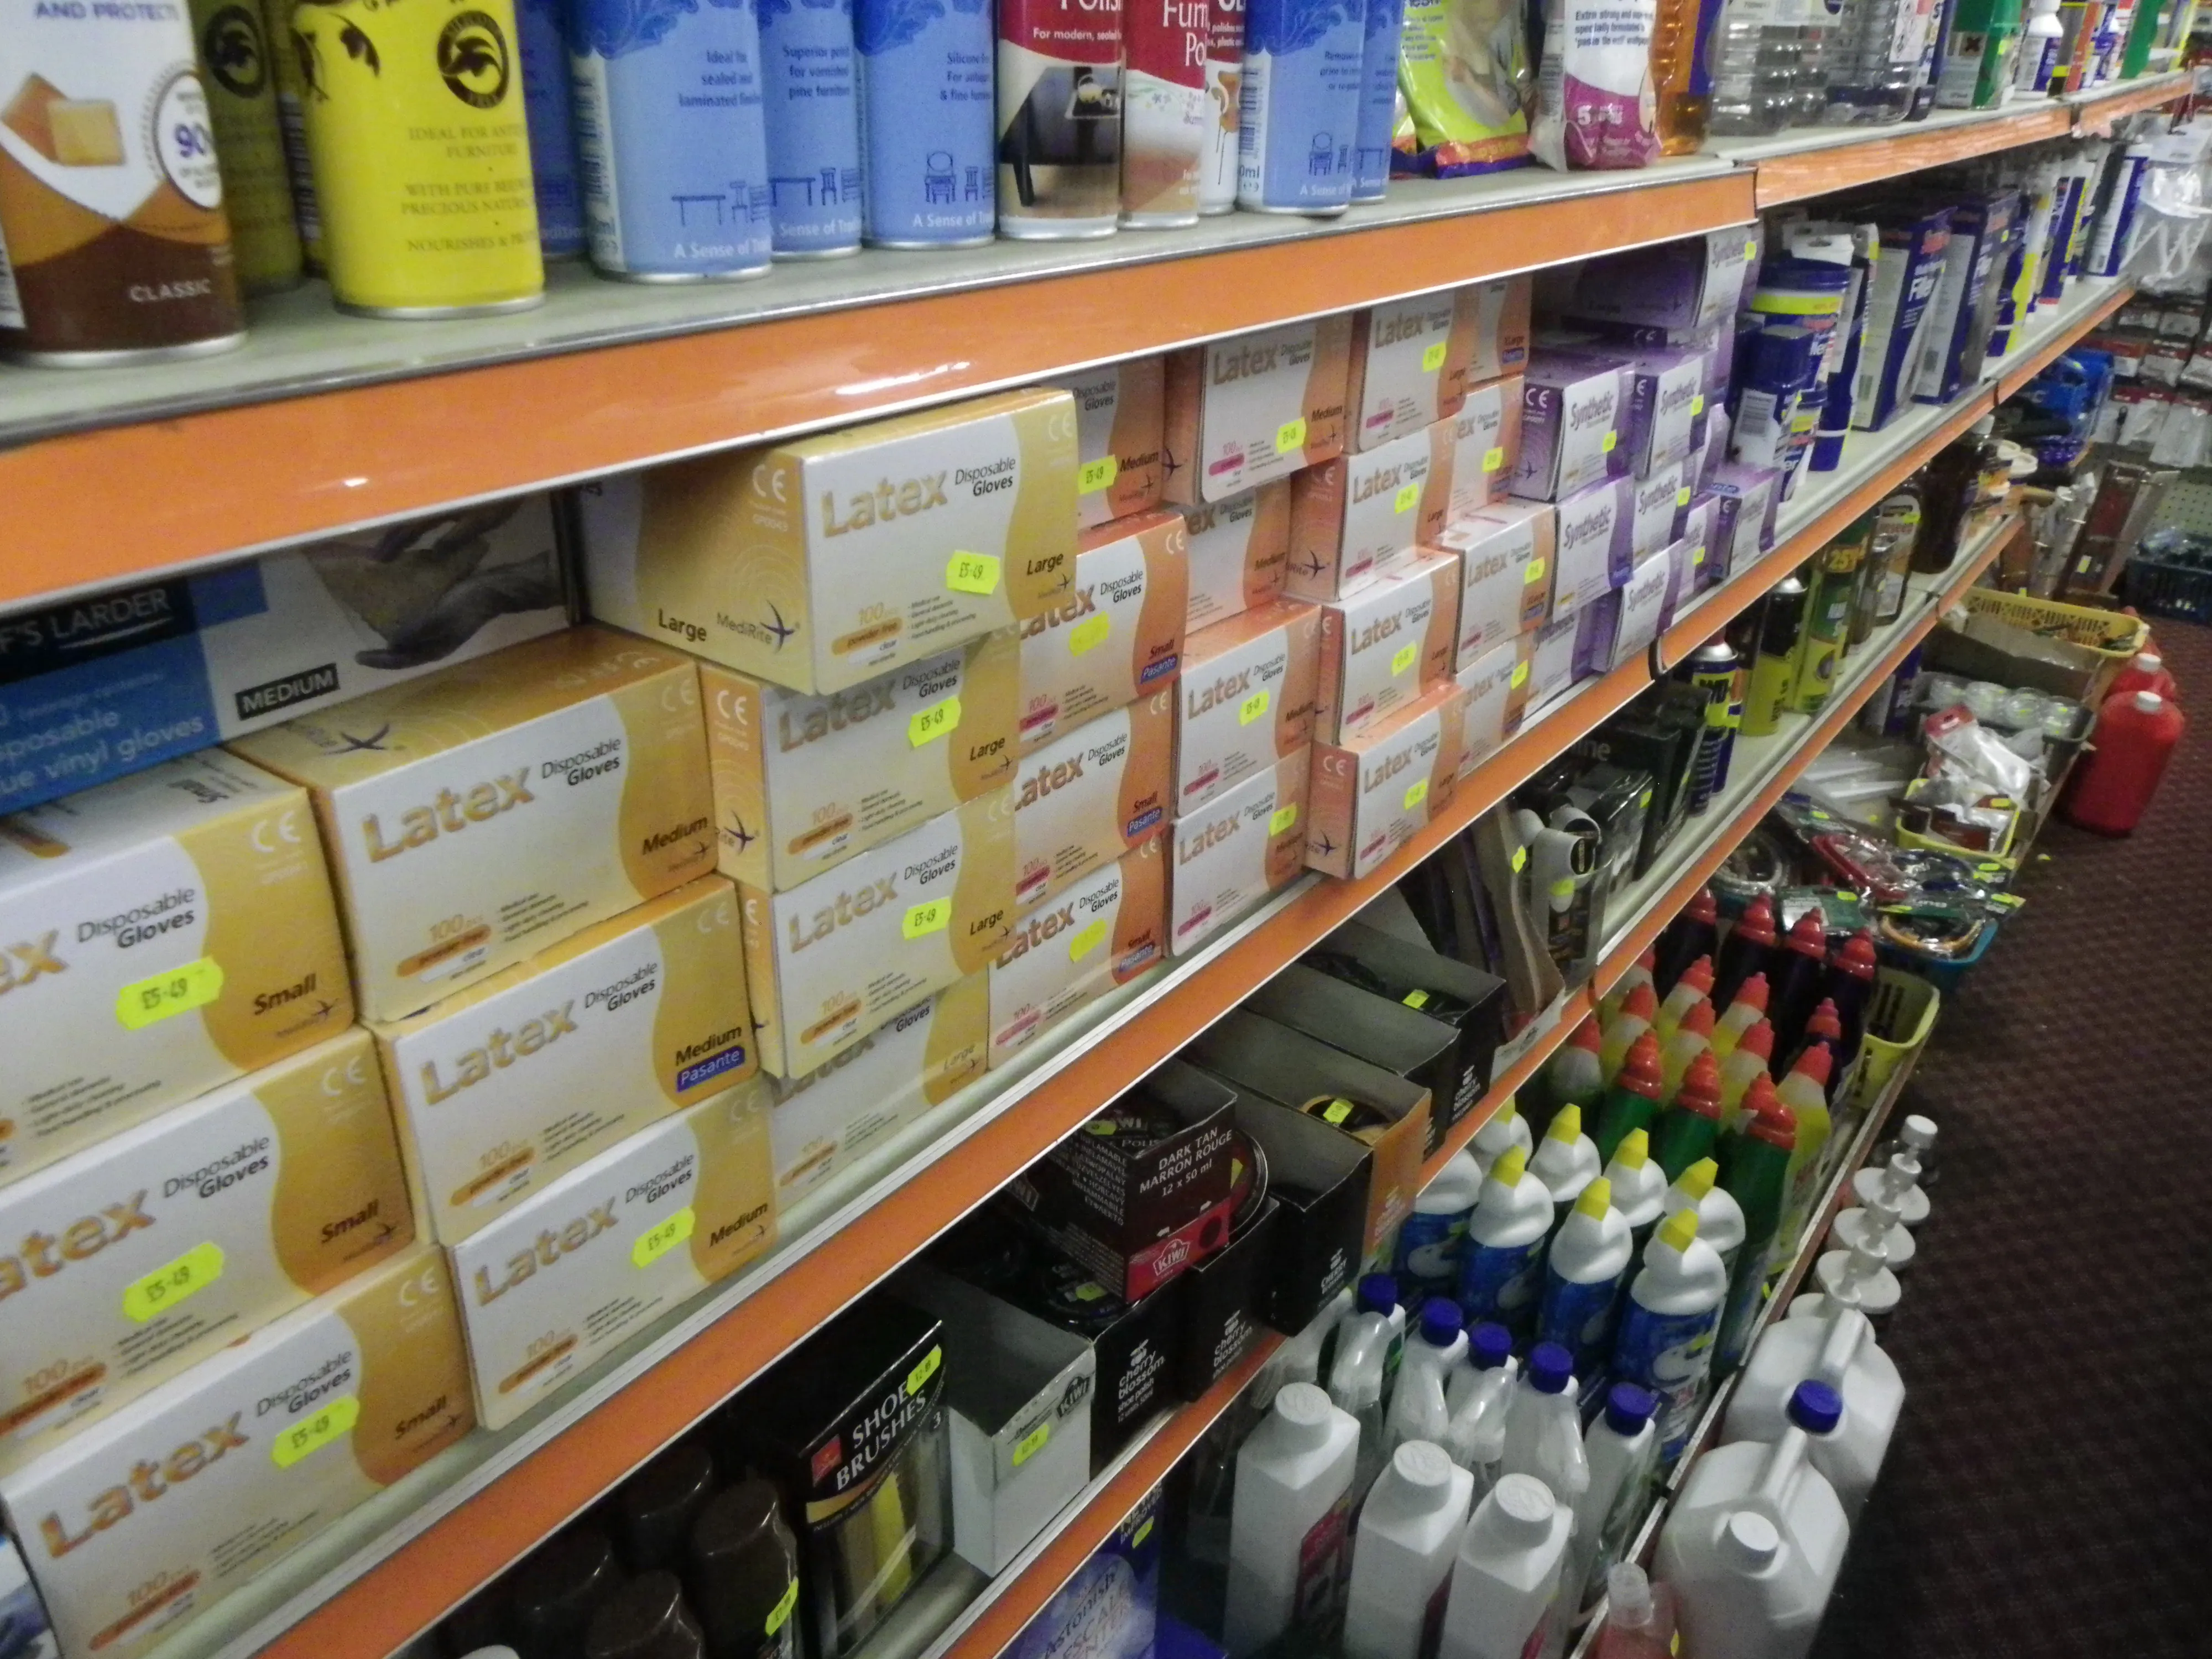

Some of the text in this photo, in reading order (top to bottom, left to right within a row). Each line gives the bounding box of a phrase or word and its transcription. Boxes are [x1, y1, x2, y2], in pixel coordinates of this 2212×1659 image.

[35, 3, 86, 19] AND
[1033, 28, 1094, 41] For modern,
[927, 213, 963, 228] Sense
[689, 242, 733, 259] Sense
[129, 278, 211, 302] CLASSIC
[1375, 311, 1425, 348] Latex
[1432, 319, 1451, 332] Gloves
[1213, 345, 1277, 385] Latex
[1281, 341, 1313, 357] Disposable
[1289, 352, 1311, 367] Gloves
[1449, 367, 1466, 381] Large
[1084, 394, 1114, 411] Gloves
[1312, 406, 1343, 422] Medium
[1571, 391, 1614, 429] Synthetic
[955, 456, 1016, 486] Disposable
[1120, 450, 1159, 472] Medium
[1404, 456, 1428, 473] Disposable
[1410, 467, 1427, 480] Gloves
[973, 476, 1014, 497] Gloves
[1353, 465, 1401, 504] Latex
[821, 470, 948, 539] Latex
[1229, 506, 1253, 523] Gloves
[1427, 509, 1443, 524] Large
[1564, 505, 1611, 550] Synthetic
[1027, 554, 1064, 577] Large
[1255, 552, 1285, 571] Medium
[1467, 552, 1507, 588] Latex
[1100, 570, 1143, 595] Disposable
[1113, 584, 1141, 603] Gloves
[1628, 570, 1666, 611] Synthetic
[52, 588, 173, 639] LARDER
[658, 608, 707, 642] Large
[717, 612, 773, 645] MediRite
[1412, 608, 1430, 623] Gloves
[1149, 639, 1175, 659] Small
[1351, 611, 1402, 655] Latex
[902, 659, 961, 692] Disposable
[1144, 656, 1176, 677] Pasante
[1254, 653, 1285, 676] Disposable
[1262, 665, 1284, 681] Gloves
[241, 670, 334, 713] MEDIUM
[919, 674, 959, 698] Gloves
[1188, 667, 1250, 720] Latex
[780, 679, 896, 754] Latex
[45, 717, 204, 779] vinyl gloves
[541, 736, 622, 780] Disposable
[971, 735, 1006, 762] Large
[1087, 732, 1129, 763] Disposable
[1099, 745, 1126, 768] Gloves
[566, 755, 621, 787] Gloves
[1014, 751, 1086, 813] Latex
[1364, 747, 1412, 794] Latex
[361, 766, 535, 864] Latex
[1133, 790, 1159, 813] Small
[1244, 792, 1275, 817] Disposable
[1253, 803, 1273, 821] Gloves
[642, 814, 709, 857] Medium
[1129, 806, 1162, 833] Pasante
[1180, 811, 1240, 865] Latex
[904, 842, 959, 881] Disposable
[919, 858, 957, 887] Gloves
[1079, 878, 1120, 910] Disposable
[1092, 890, 1119, 914] Gloves
[78, 888, 196, 943] Disposable
[116, 908, 195, 951] Gloves
[789, 872, 899, 955] Latex
[971, 908, 1005, 936] Large
[996, 901, 1076, 971] Latex
[254, 973, 317, 1016] Small
[583, 961, 659, 1010] Disposable
[607, 978, 656, 1012] Gloves
[896, 1004, 930, 1032] Gloves
[420, 999, 580, 1107] Latex
[675, 1024, 742, 1067] Medium
[679, 1049, 740, 1086] Pasante
[164, 1134, 270, 1199] Disposable
[1139, 1160, 1192, 1193] MARRON
[1196, 1129, 1232, 1162] ROUGE
[1159, 1128, 1219, 1171] DARK TAN
[197, 1154, 269, 1200] Gloves
[625, 1154, 695, 1206] Disposable
[646, 1168, 692, 1206] Gloves
[1162, 1186, 1173, 1197] 12
[1186, 1170, 1197, 1182] 50
[1200, 1159, 1212, 1174] ml
[321, 1199, 380, 1244] Small
[709, 1201, 769, 1249] Medium
[473, 1196, 620, 1308] Latex
[1160, 1247, 1185, 1270] KIWI
[1214, 1321, 1248, 1356] cherry
[255, 1349, 352, 1419] Disposable
[1118, 1355, 1165, 1400] blossom
[1119, 1349, 1158, 1387] cherry
[288, 1366, 351, 1415] Gloves
[1058, 1379, 1091, 1414] KIWI
[1118, 1378, 1155, 1413] shoe polish
[395, 1395, 447, 1441] Small
[853, 1380, 908, 1449] SHOE
[837, 1389, 926, 1490] BRUSHES
[39, 1410, 250, 1559] Latex
